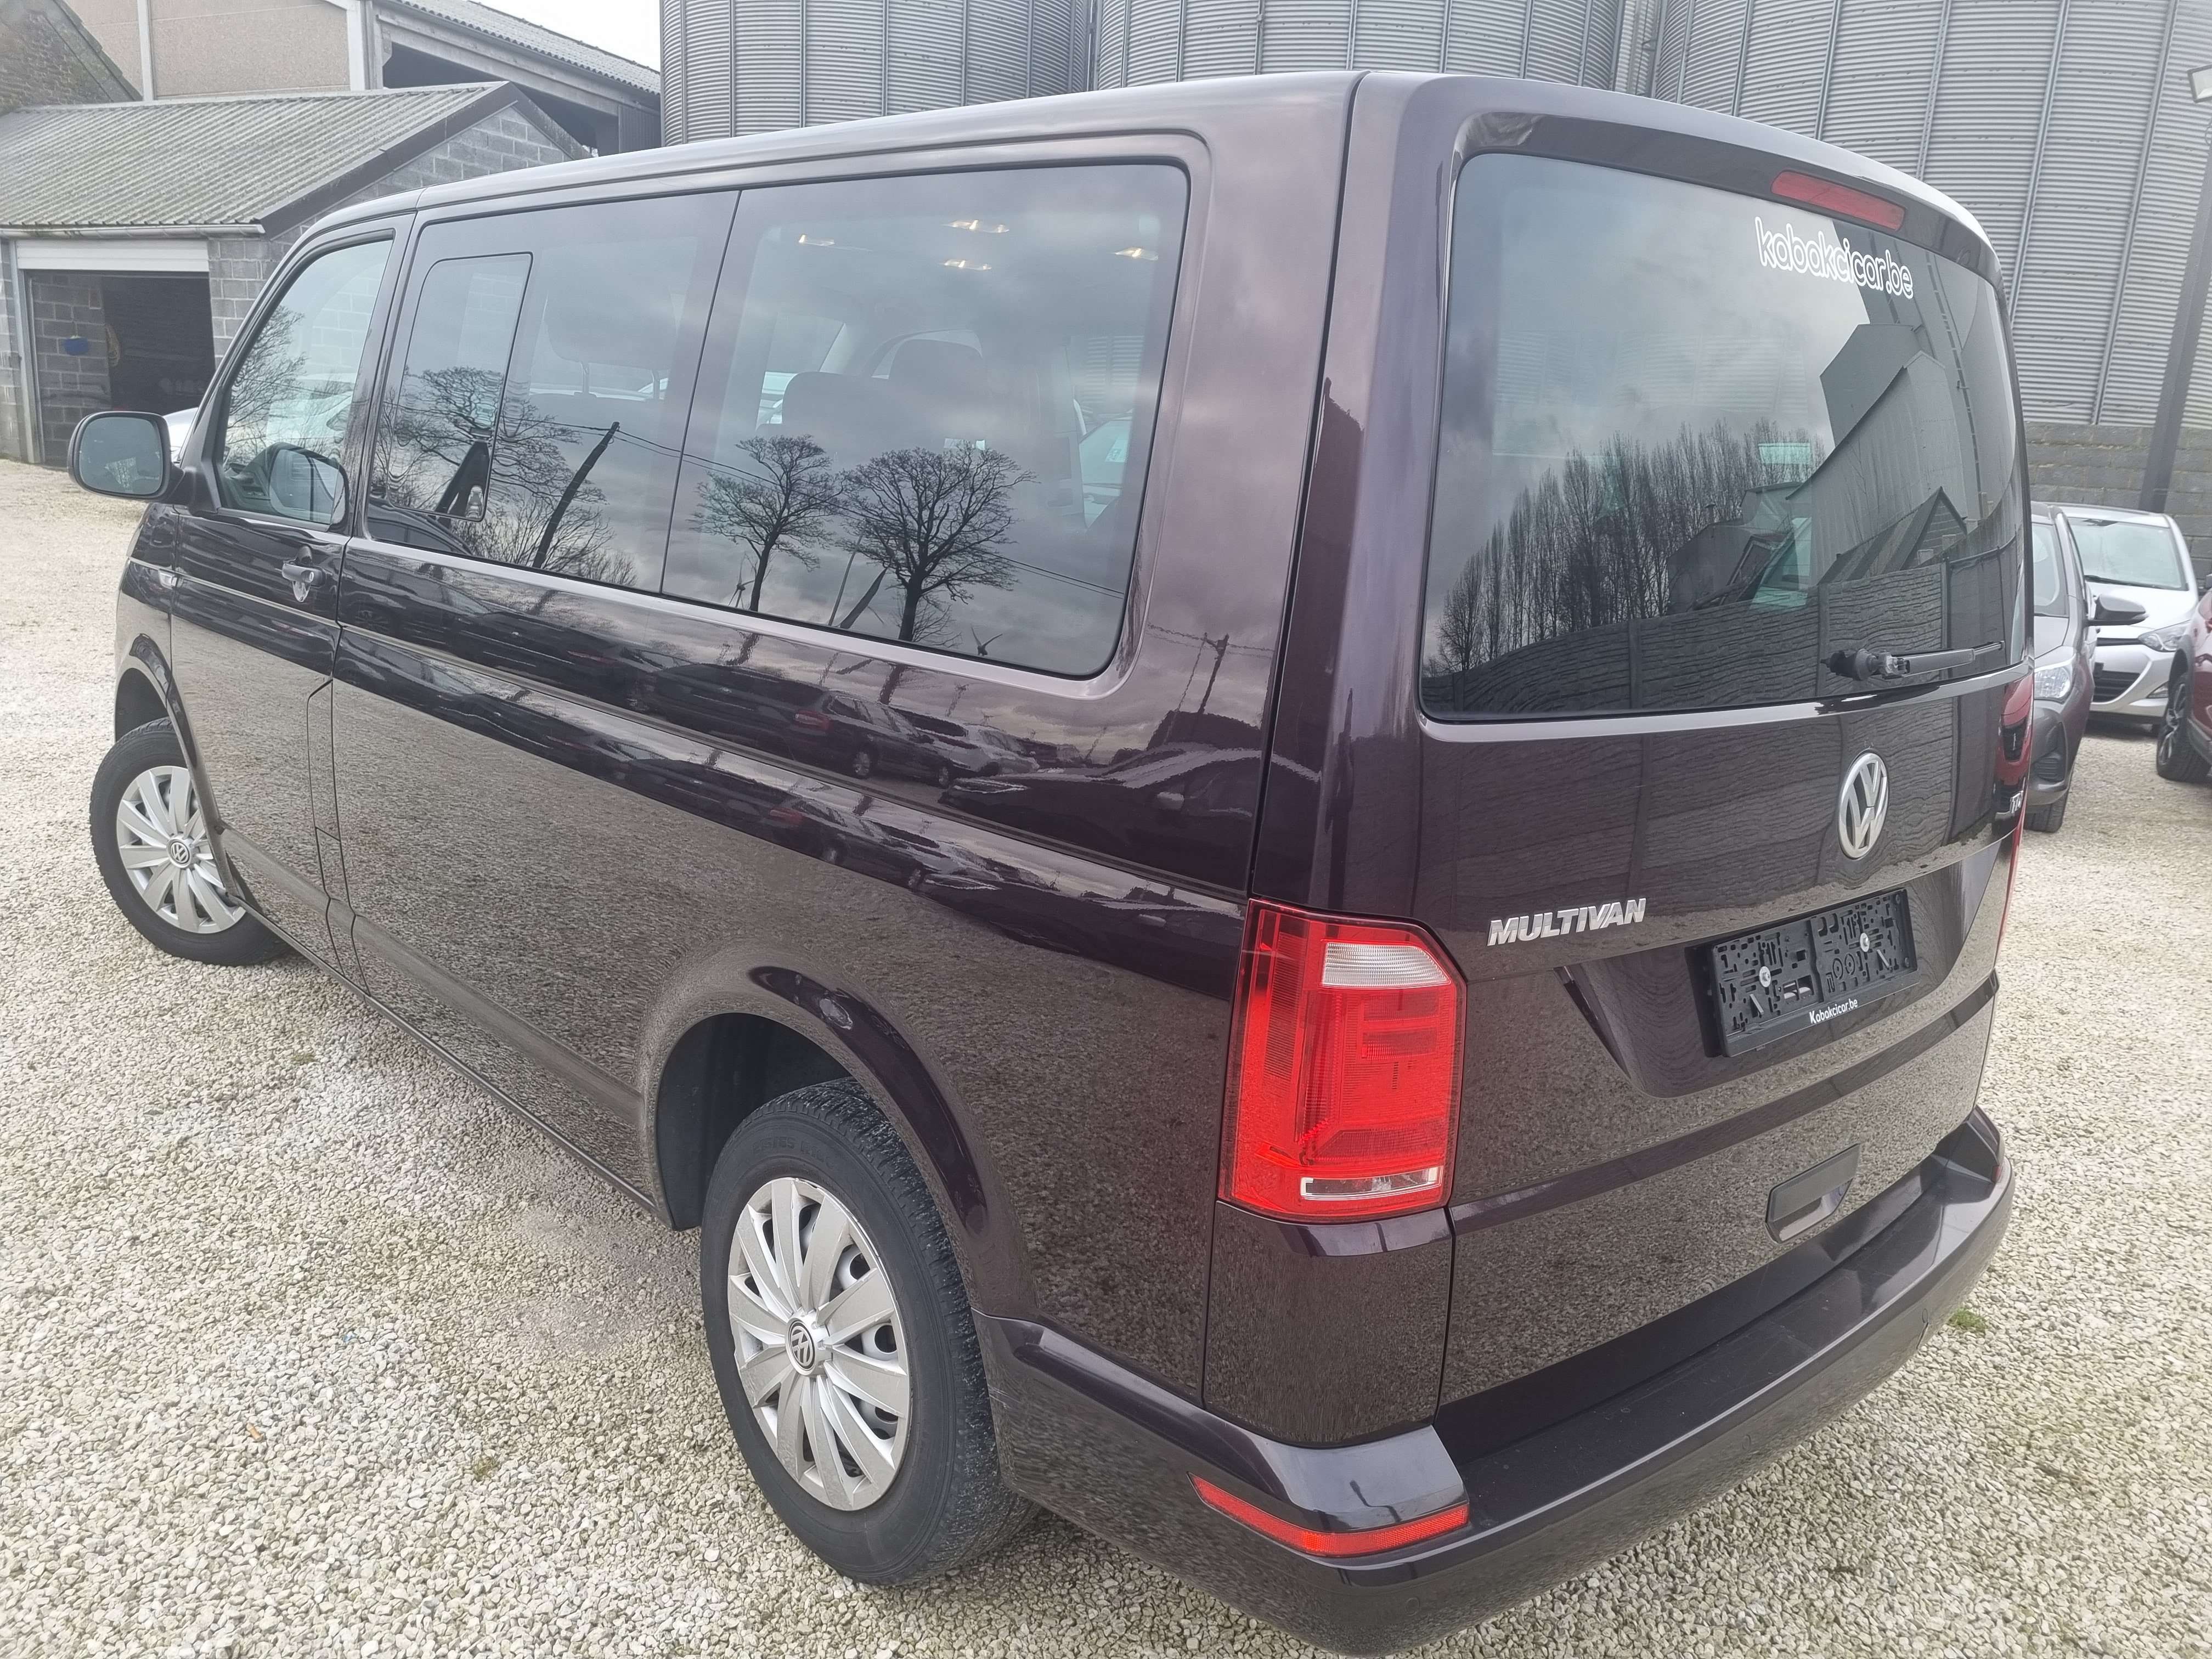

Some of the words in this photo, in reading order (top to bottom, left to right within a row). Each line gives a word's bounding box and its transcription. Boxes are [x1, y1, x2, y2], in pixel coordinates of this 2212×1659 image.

[1755, 216, 1914, 299] kabakcicar.be
[1487, 898, 1646, 946] MULTIVAN
[1809, 998, 1858, 1024] Kabakcicar.be
